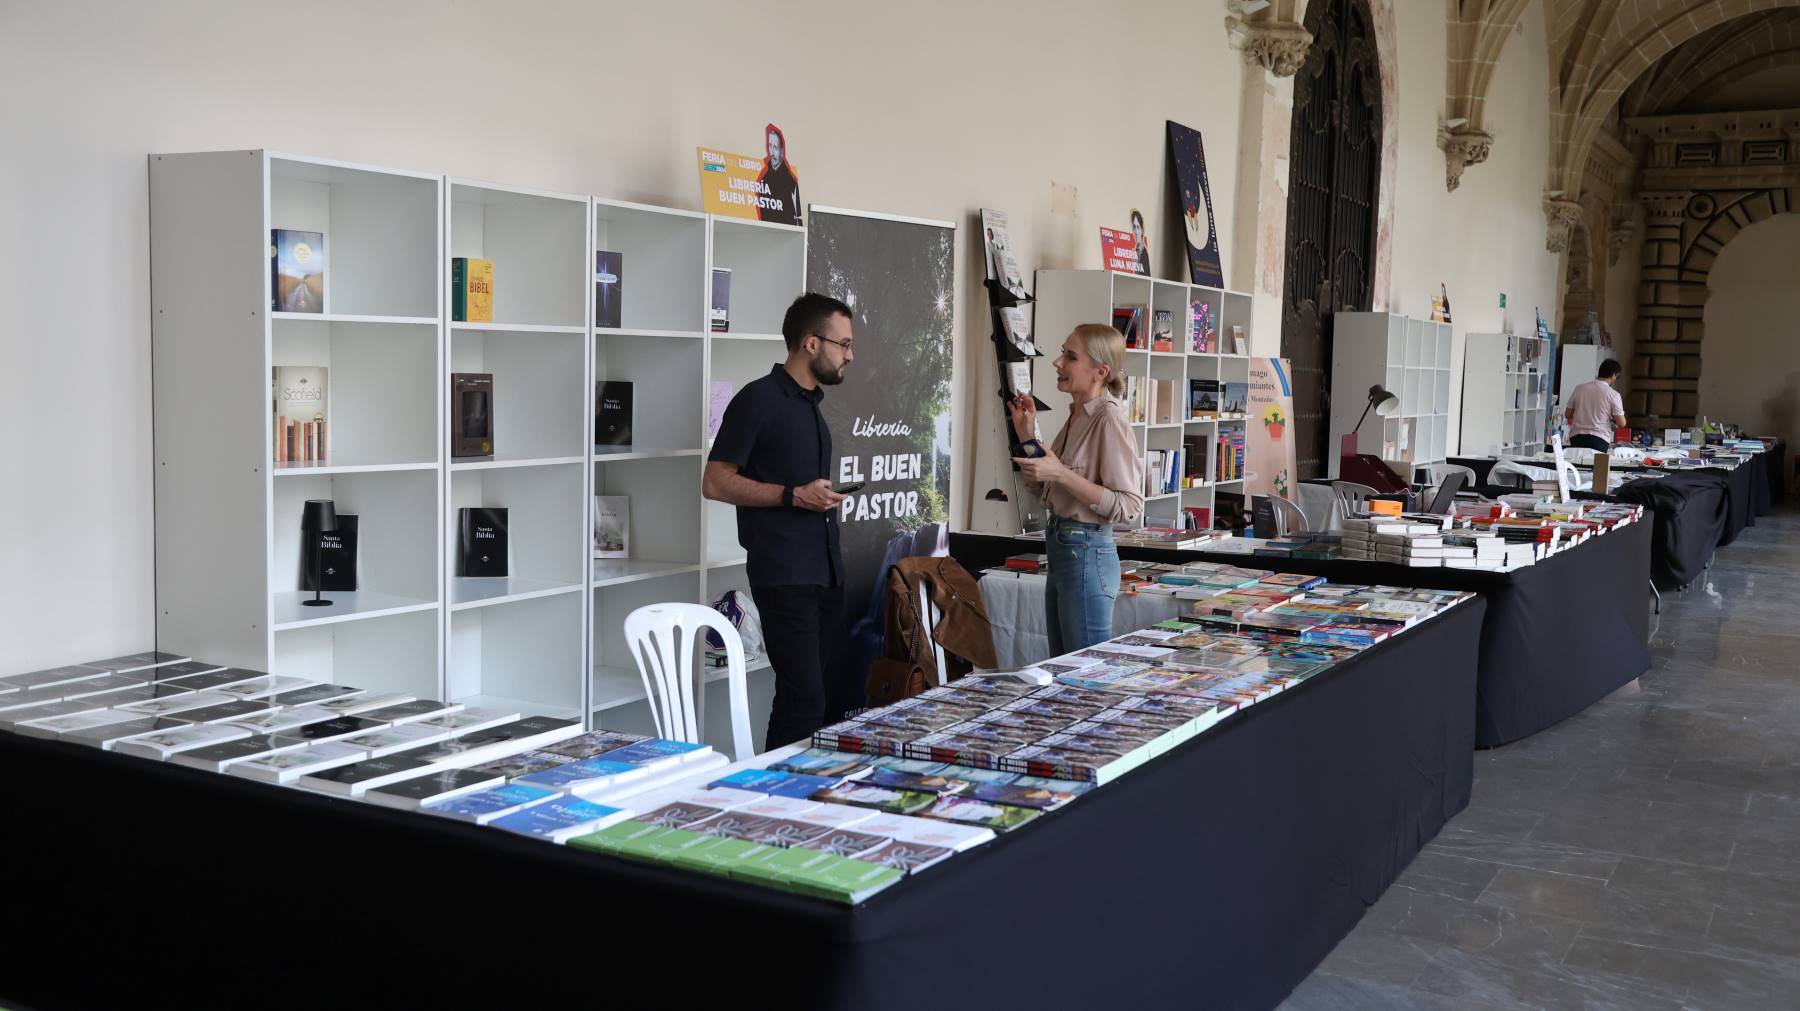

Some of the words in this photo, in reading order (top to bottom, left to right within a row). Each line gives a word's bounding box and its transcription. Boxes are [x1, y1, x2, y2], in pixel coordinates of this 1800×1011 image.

[739, 158, 762, 171] LIBRO
[728, 177, 771, 195] LIBRERÍA
[719, 190, 745, 205] BUEN
[747, 196, 783, 211] PASTOR
[470, 282, 489, 294] BIBEL
[1249, 381, 1275, 391] miantes
[284, 387, 322, 401] Scofield
[852, 413, 912, 438] Librería
[840, 456, 864, 483] EL
[871, 453, 921, 482] BUEN
[842, 491, 918, 522] PASTOR
[476, 531, 495, 539] Biblia
[321, 541, 343, 549] Biblia
